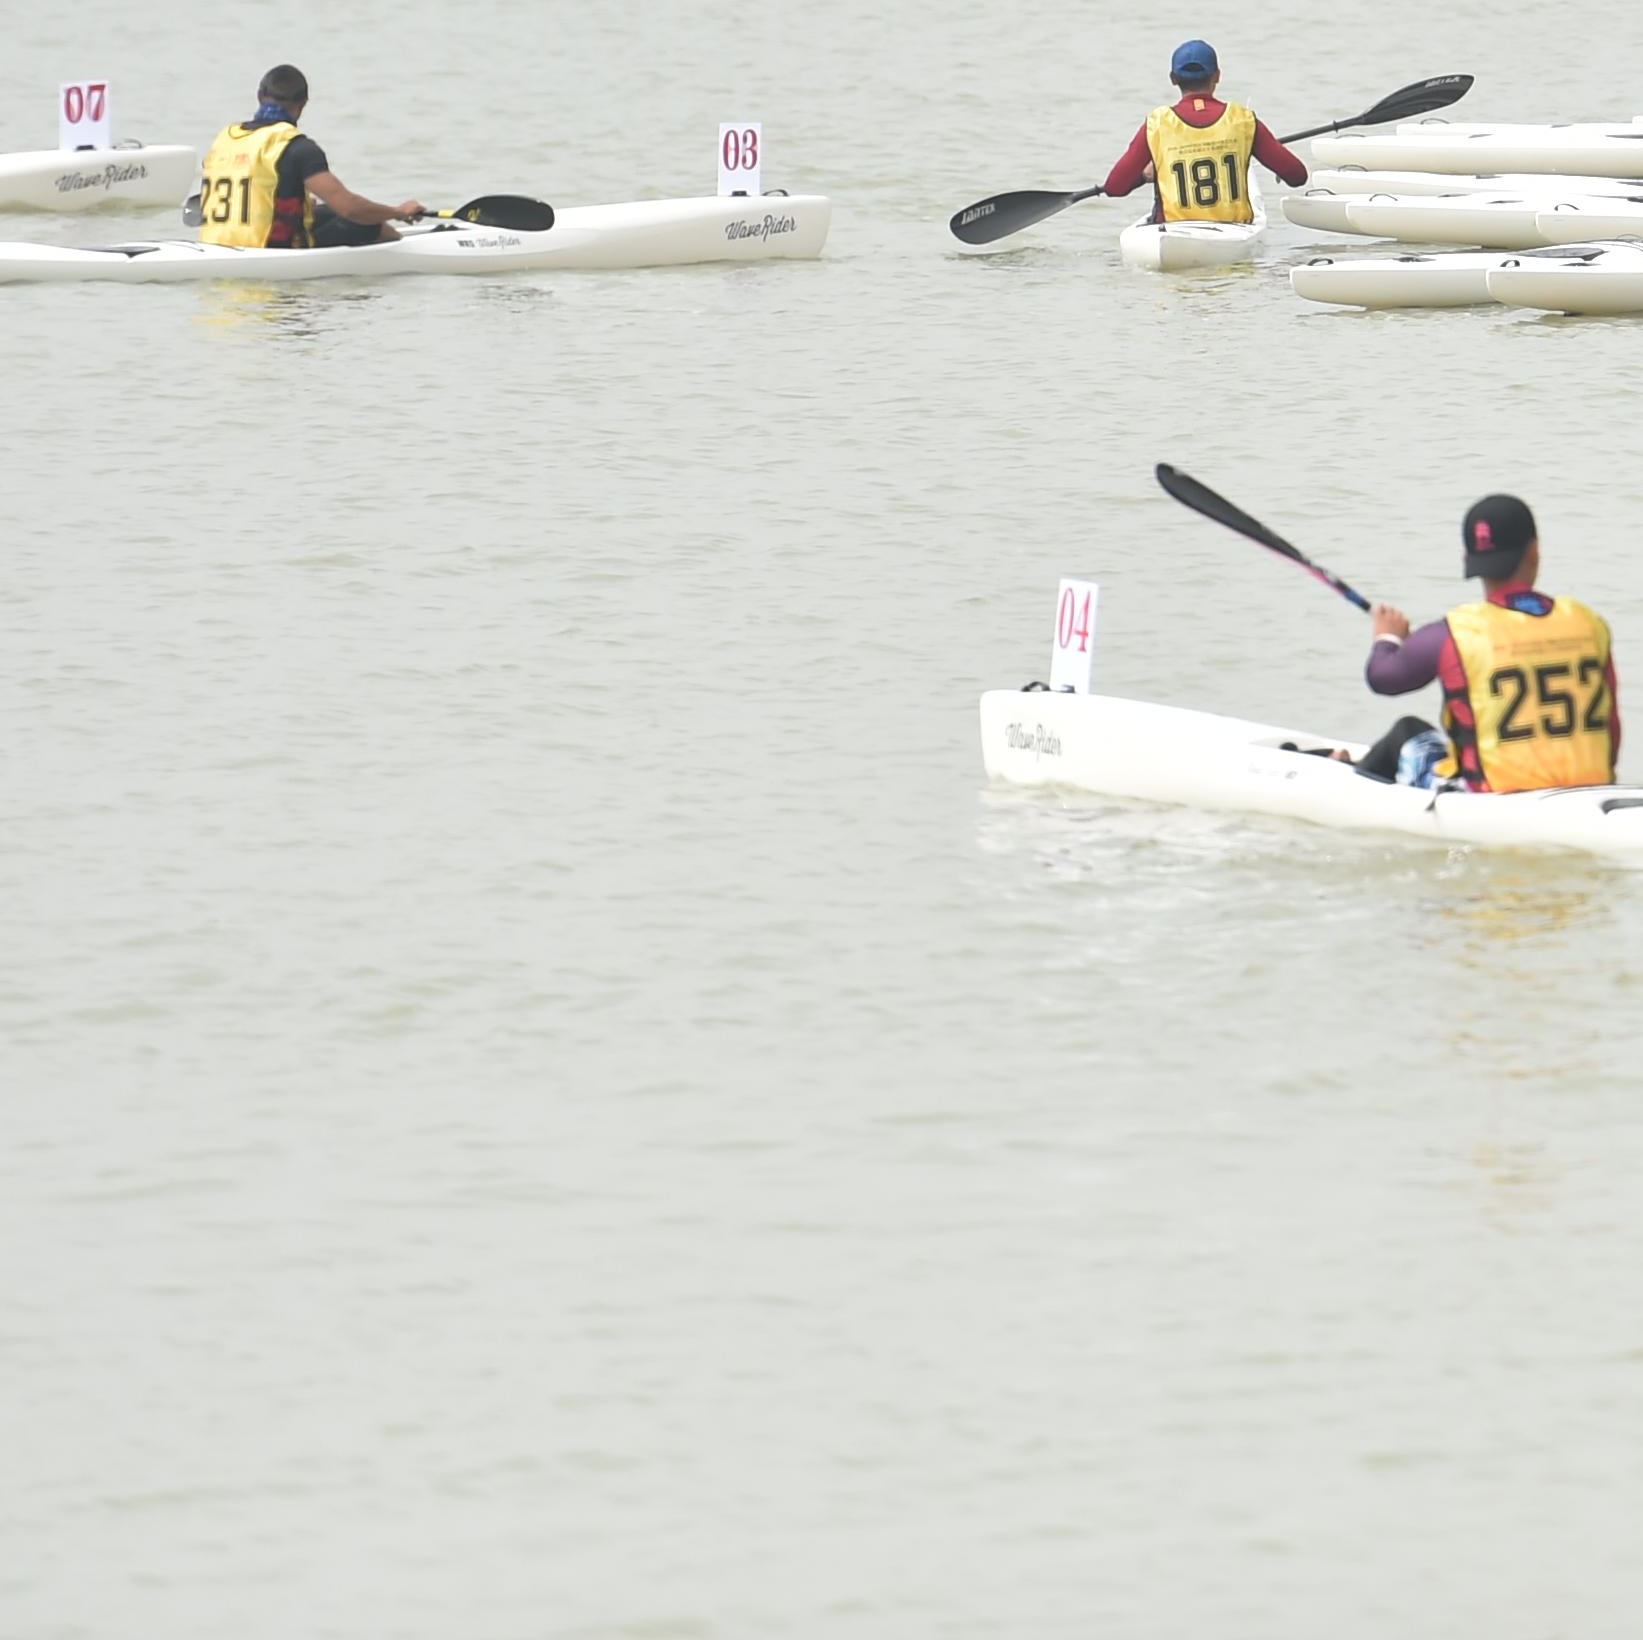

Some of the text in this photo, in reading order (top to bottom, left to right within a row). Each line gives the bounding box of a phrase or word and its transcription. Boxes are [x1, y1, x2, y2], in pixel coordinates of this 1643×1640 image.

[64, 83, 107, 124] 07
[722, 129, 758, 171] 03
[1170, 151, 1241, 210] 181
[1057, 586, 1094, 653] 04
[1489, 654, 1611, 744] 252
